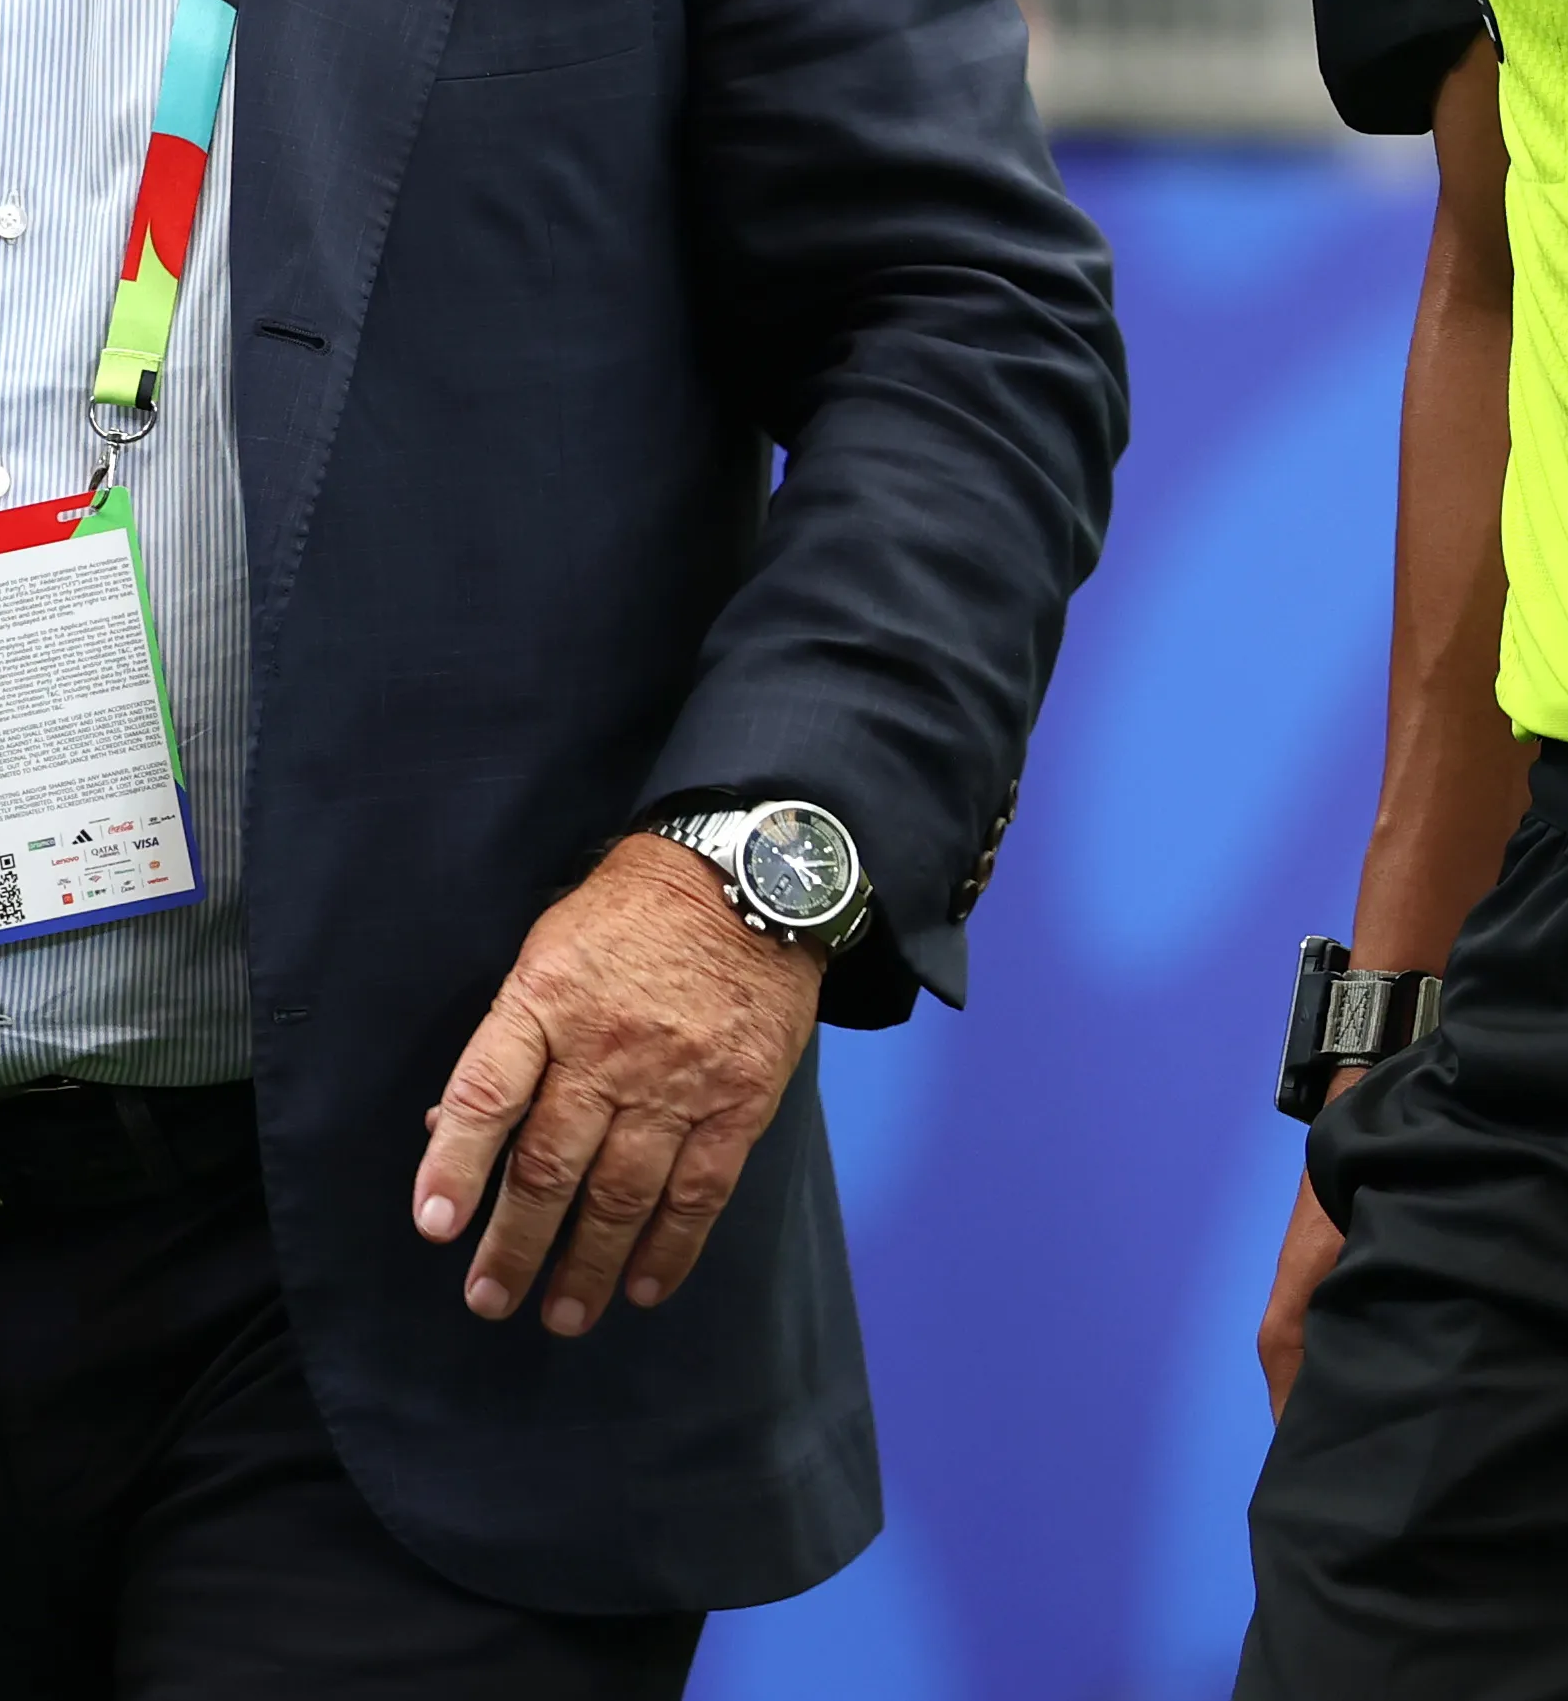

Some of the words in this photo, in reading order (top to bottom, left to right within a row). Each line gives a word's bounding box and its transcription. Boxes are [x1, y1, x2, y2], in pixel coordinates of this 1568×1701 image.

[90, 843, 119, 857] QATAR
[132, 836, 159, 850] VISA
[51, 854, 79, 866] Lenovo
